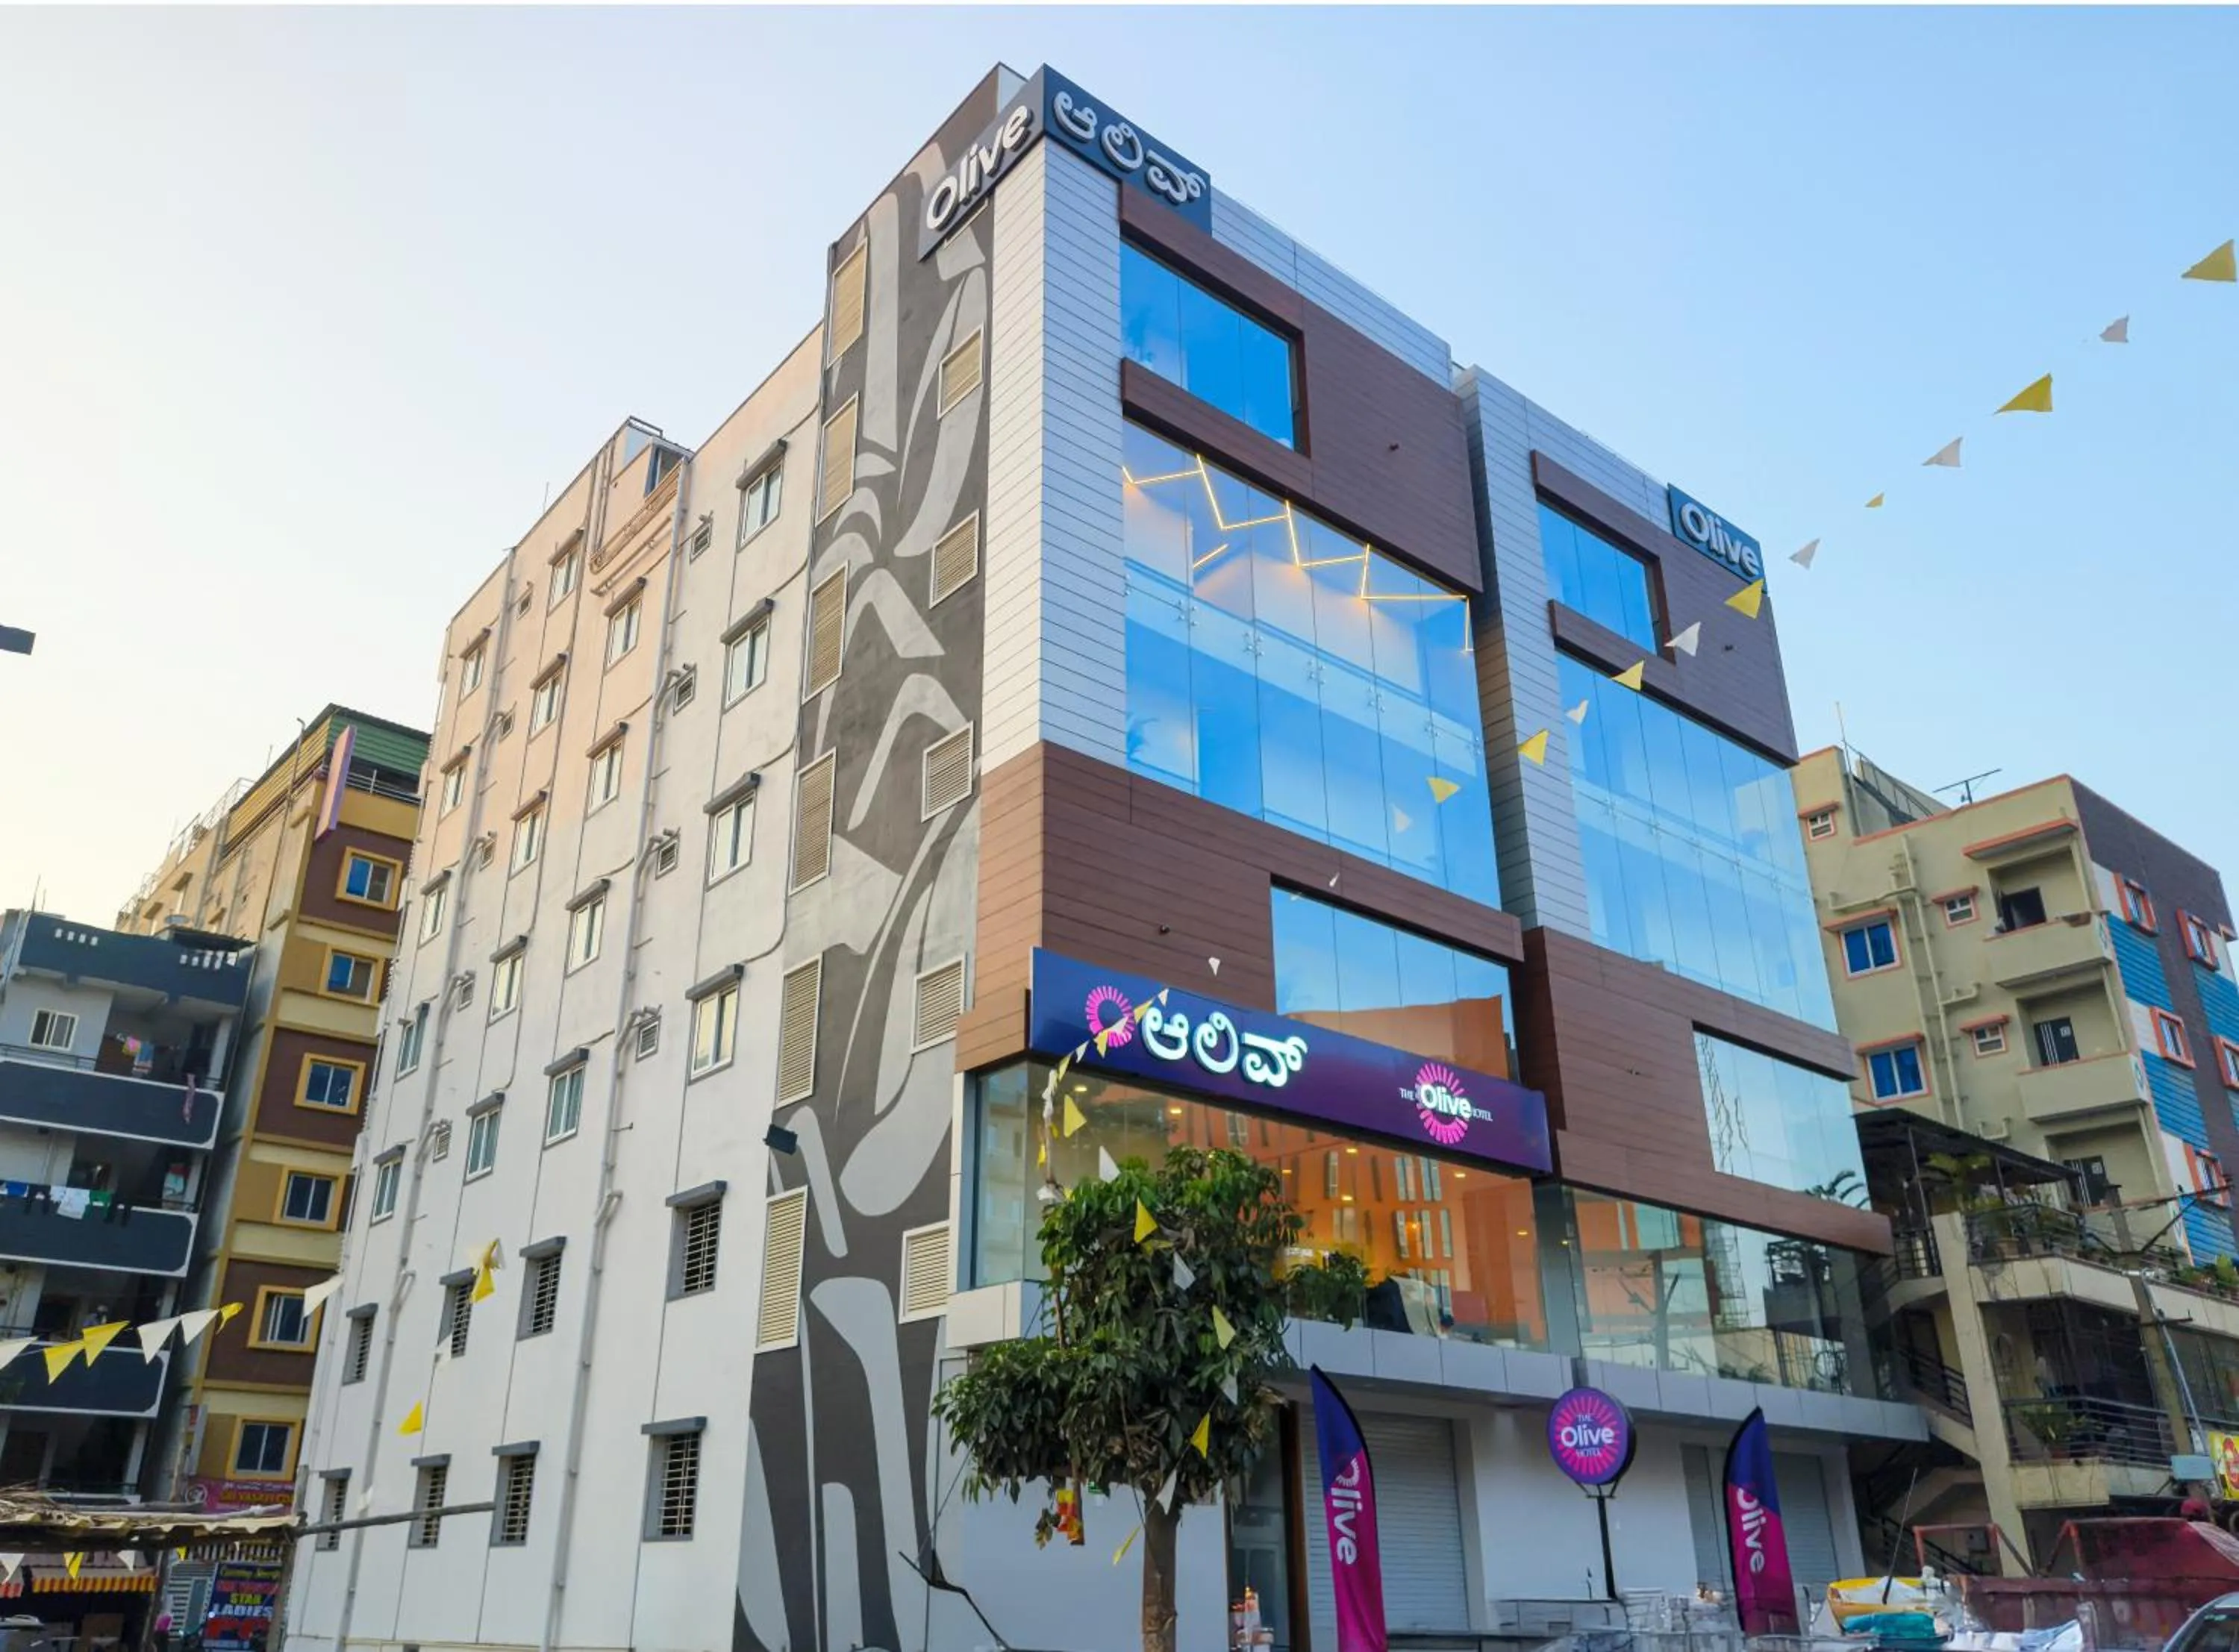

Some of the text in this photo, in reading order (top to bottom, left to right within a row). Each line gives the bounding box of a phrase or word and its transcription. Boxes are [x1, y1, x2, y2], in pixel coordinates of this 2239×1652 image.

[926, 104, 1031, 231] Olive
[1681, 501, 1762, 577] Olive
[1420, 1083, 1472, 1119] Olive
[1561, 1423, 1615, 1448] Olive
[212, 1603, 274, 1618] LADIES
[230, 1592, 262, 1605] STAR
